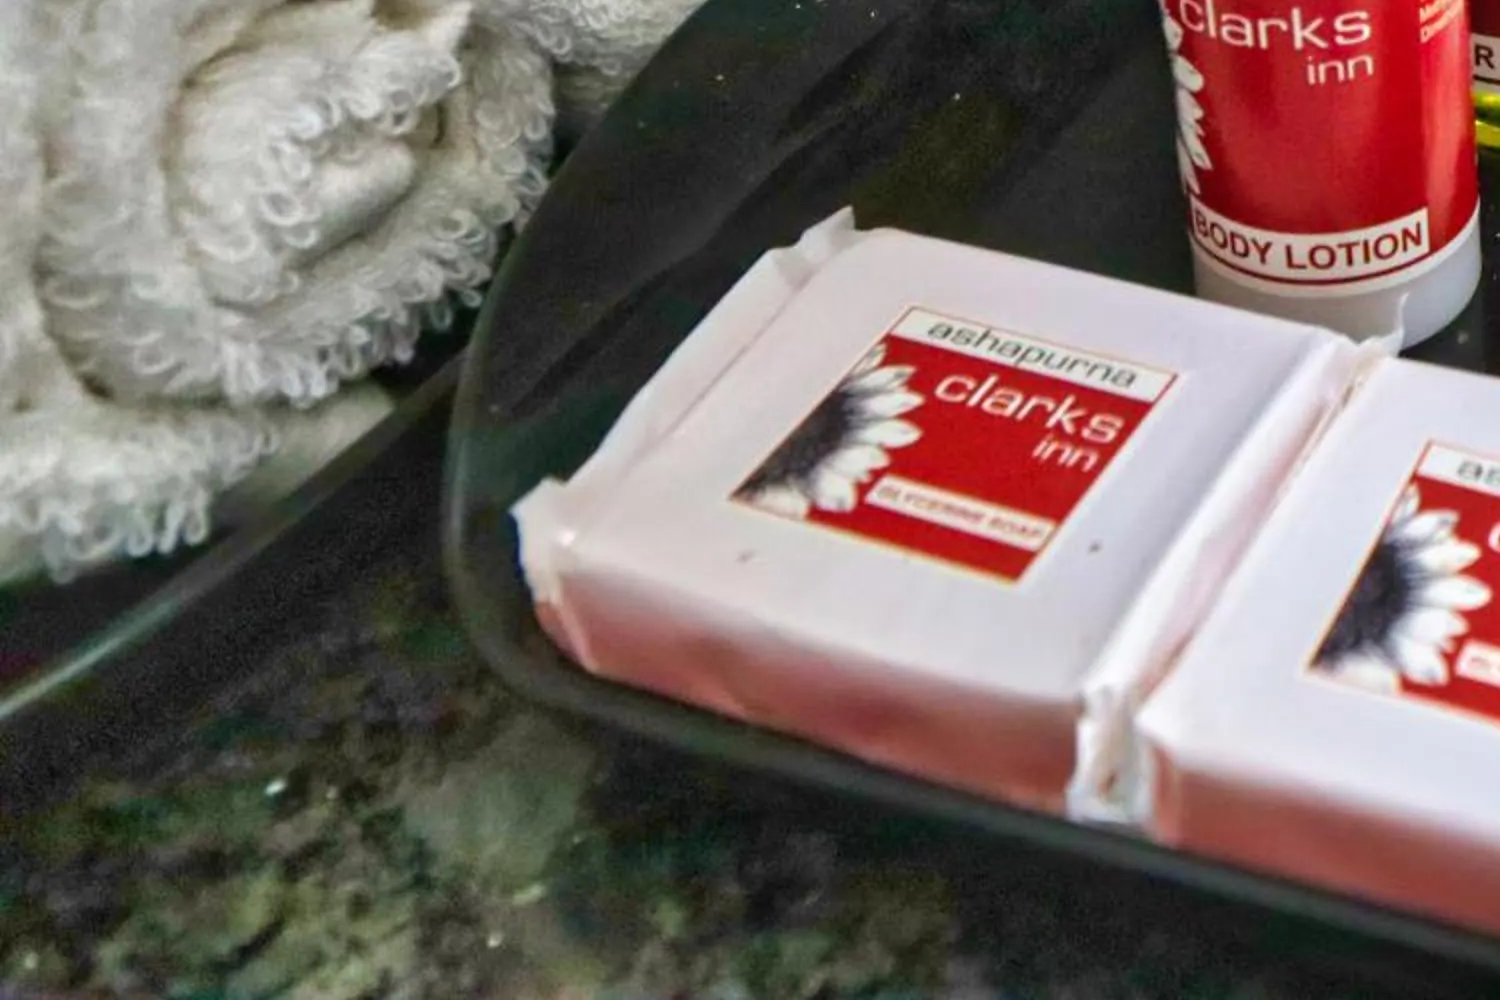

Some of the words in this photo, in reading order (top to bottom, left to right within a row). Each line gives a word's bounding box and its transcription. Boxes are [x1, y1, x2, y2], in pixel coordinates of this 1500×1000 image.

[1306, 55, 1375, 87] inn
[1195, 212, 1274, 266] BODY
[1285, 220, 1423, 271] LOTION
[926, 320, 1137, 388] ashapurna
[934, 373, 1125, 445] clarks
[1032, 433, 1100, 473] inn
